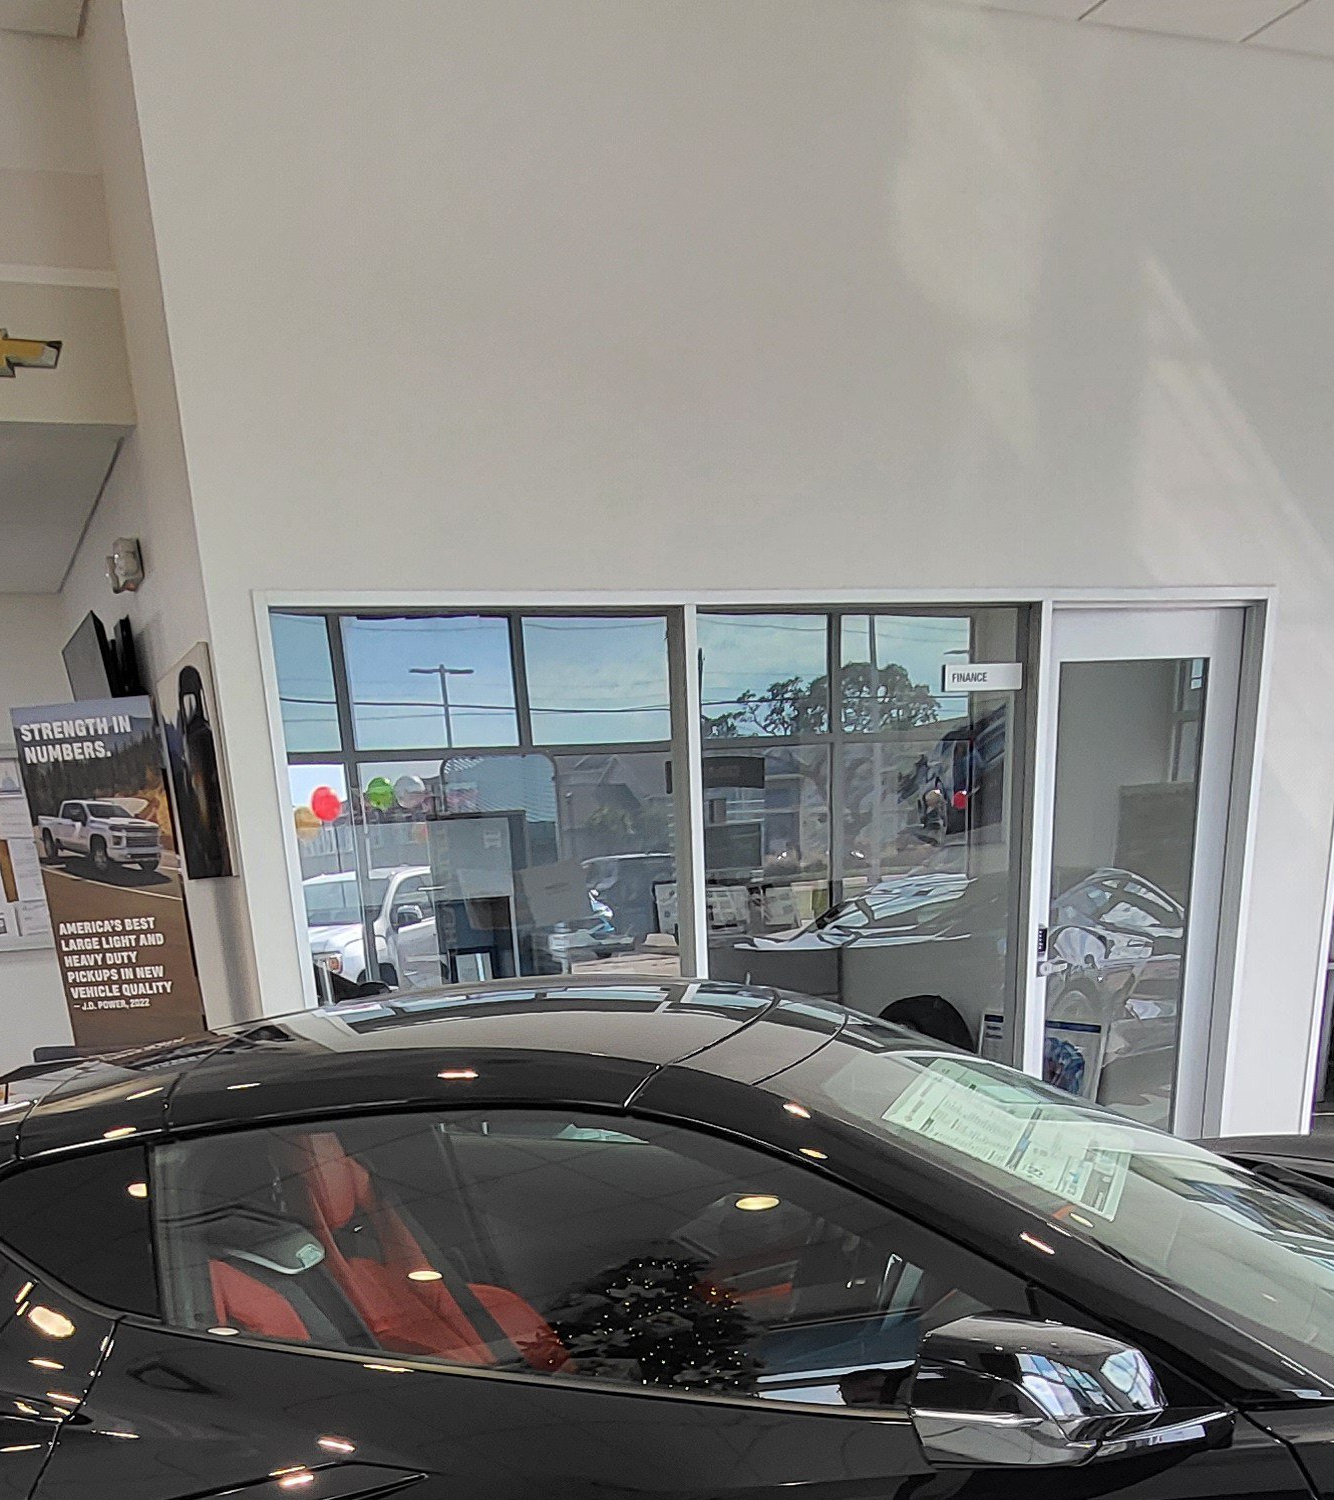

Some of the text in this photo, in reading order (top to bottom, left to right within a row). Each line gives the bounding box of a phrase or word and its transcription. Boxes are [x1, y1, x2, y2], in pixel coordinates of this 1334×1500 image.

[952, 672, 988, 683] FINANCE
[20, 715, 132, 742] STRENGTH IN
[24, 741, 112, 765] NUMBERS.
[59, 919, 123, 935] AMERICA'S
[124, 917, 155, 931] BEST
[61, 933, 165, 951] LARGE LIGHT AND
[64, 951, 138, 967] HEAVY DUTY
[67, 966, 164, 983] PICKUPS IN NEW
[70, 981, 172, 999] VEHICLE QUALITY
[82, 1001, 97, 1011] J.D.
[98, 999, 129, 1010] POWER,
